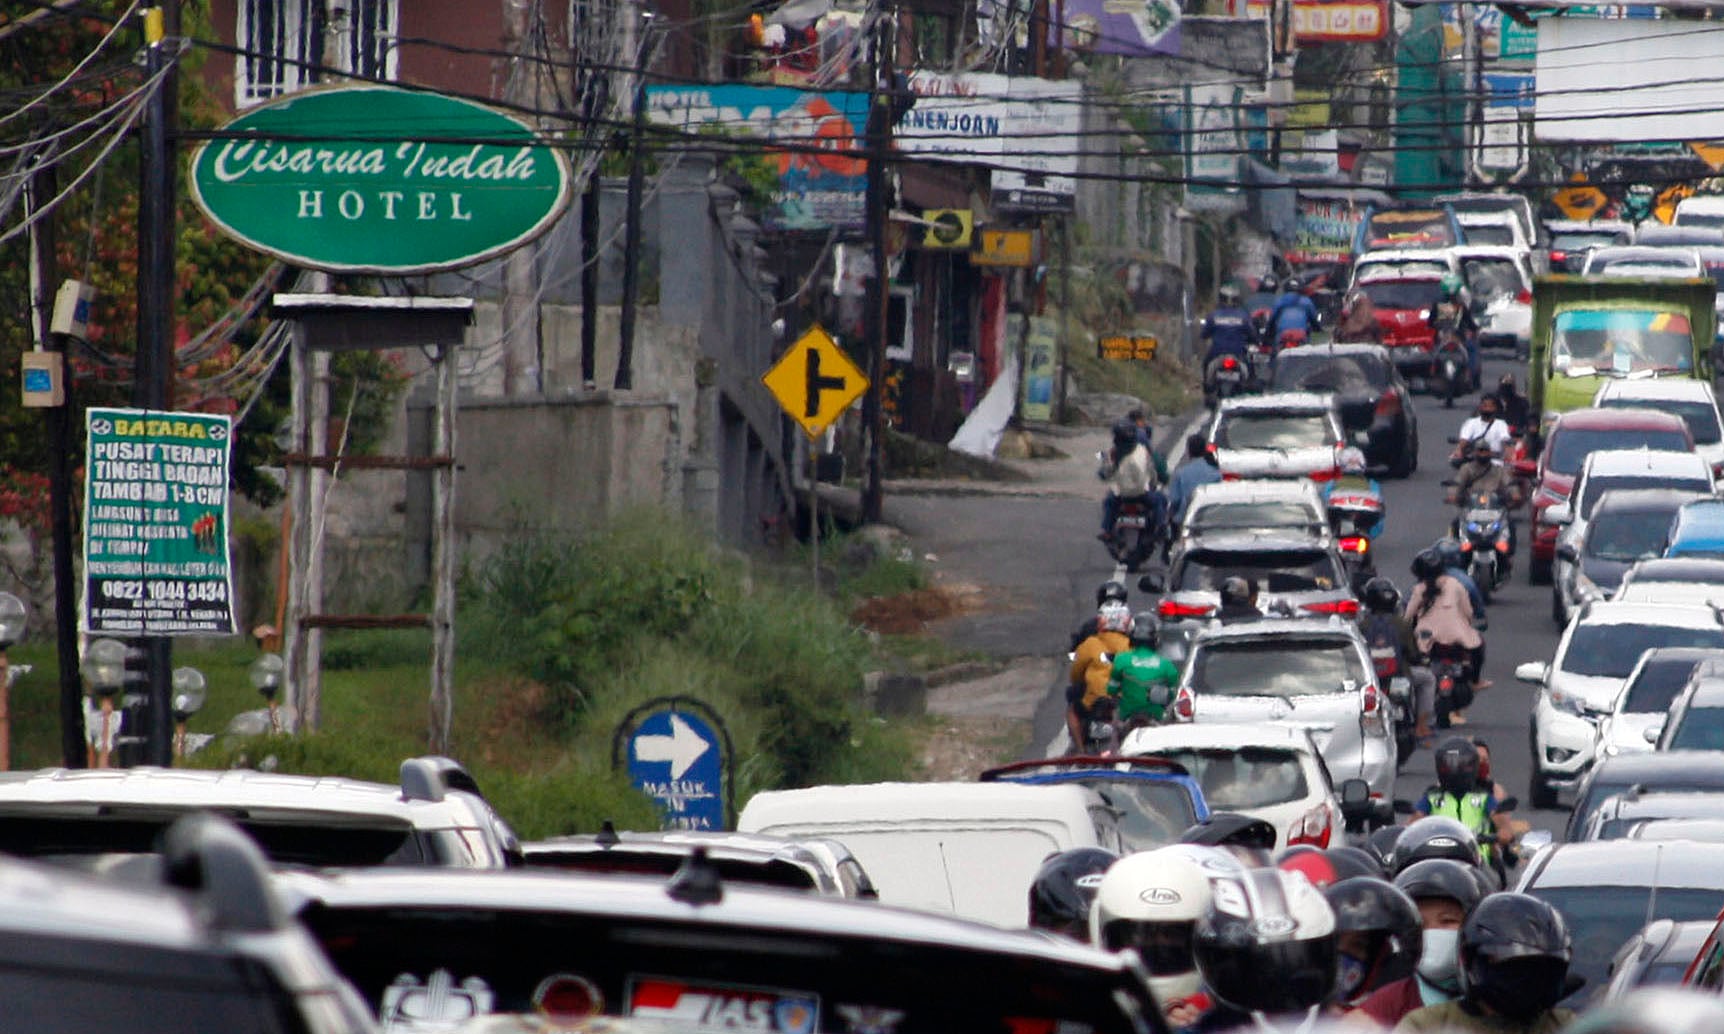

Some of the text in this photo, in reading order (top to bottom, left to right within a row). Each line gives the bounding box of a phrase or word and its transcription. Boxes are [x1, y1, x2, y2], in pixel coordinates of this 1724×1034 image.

[214, 128, 537, 183] Cisarua Indah
[298, 189, 472, 221] HOTEL
[94, 442, 223, 465] PUSAT TERAPI
[94, 461, 161, 482] TINGGI
[102, 580, 144, 600] 0822
[188, 583, 226, 602] 3434
